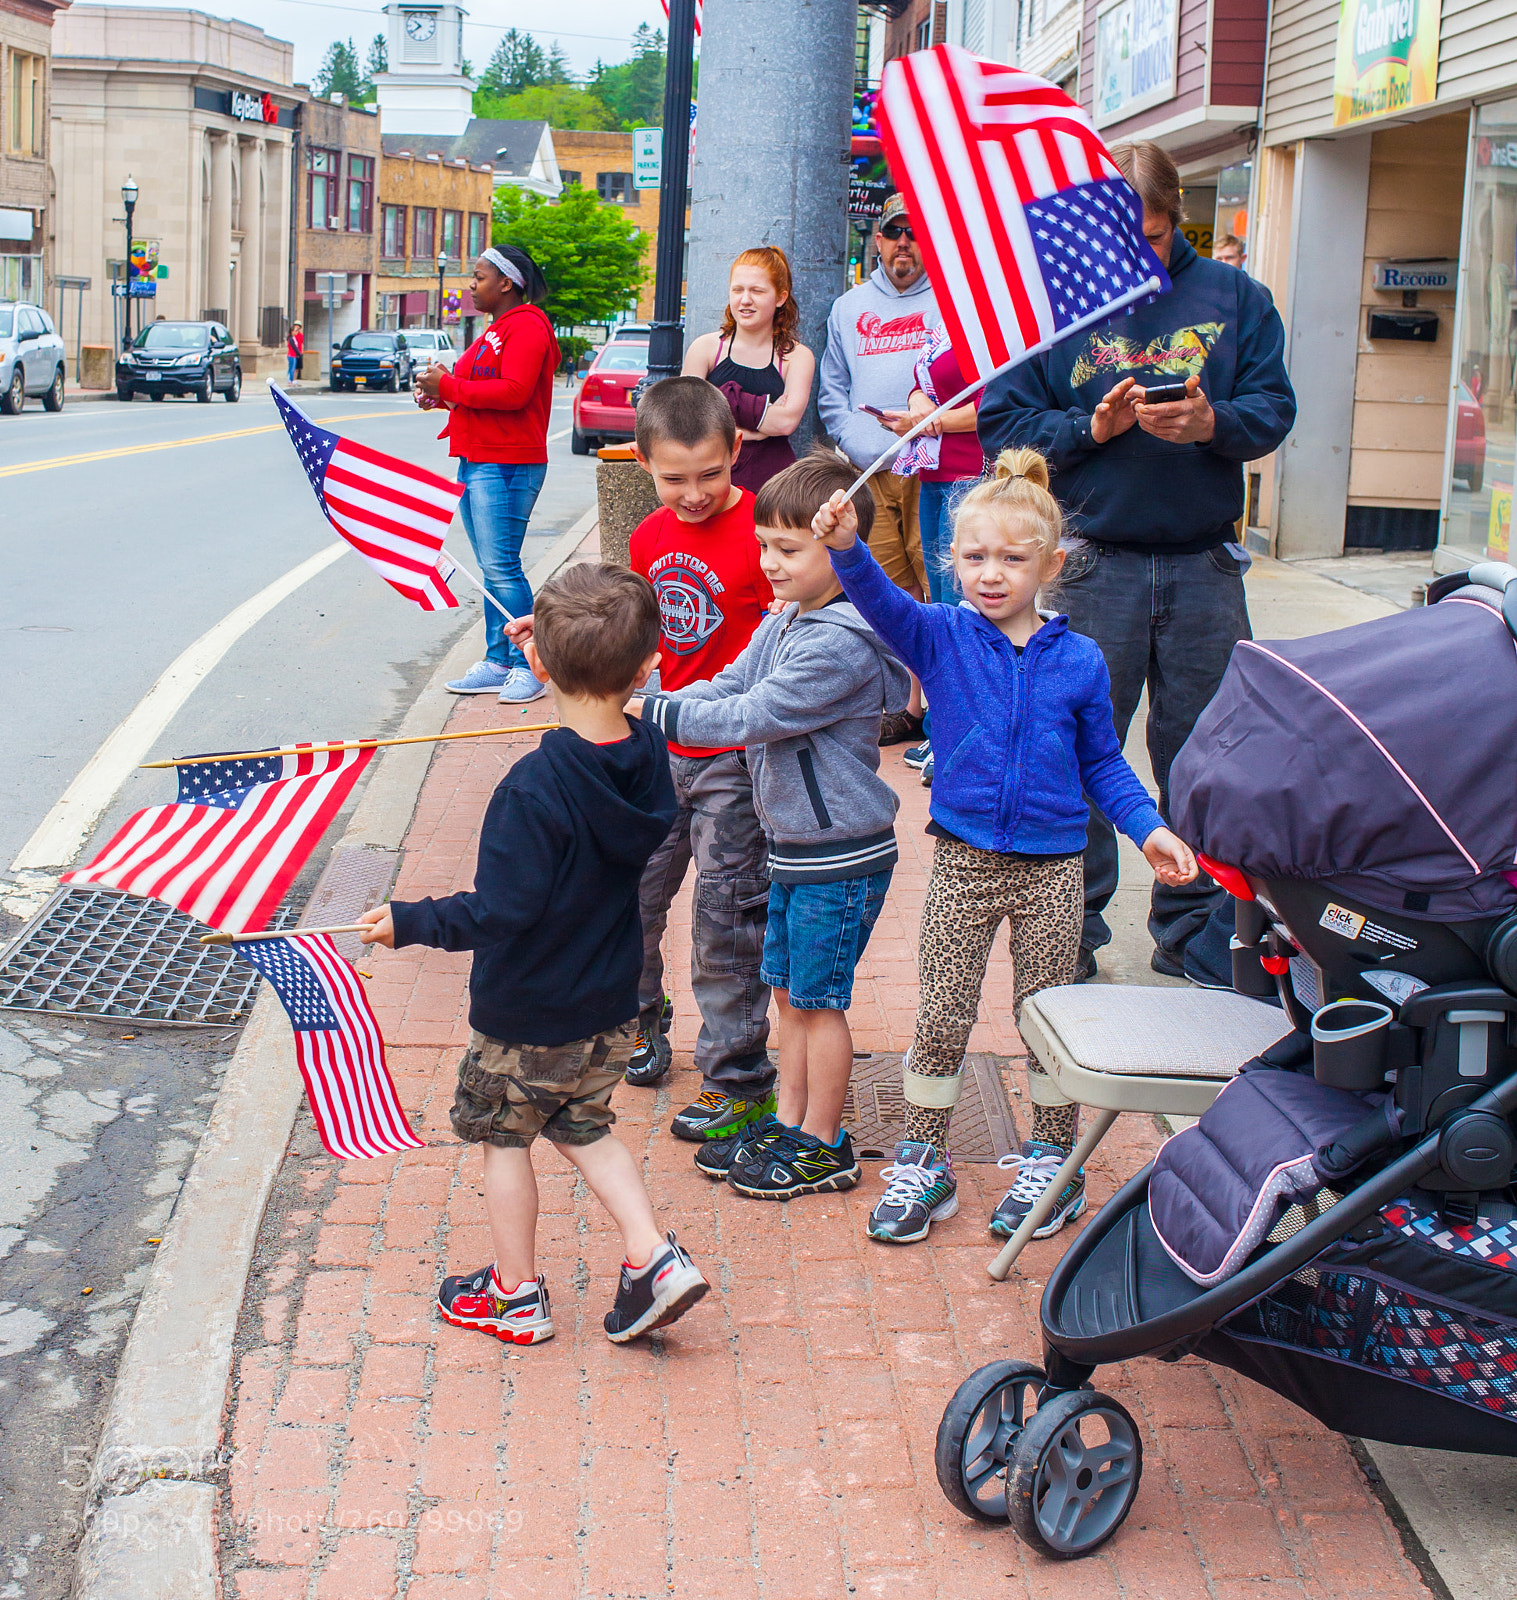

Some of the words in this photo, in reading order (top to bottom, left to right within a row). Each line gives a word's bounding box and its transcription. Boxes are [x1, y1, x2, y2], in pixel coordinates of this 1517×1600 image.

[1356, 0, 1414, 55] Gabriel
[231, 91, 264, 122] KeyBank
[1350, 83, 1387, 118] Mexican
[1388, 70, 1412, 108] Food
[1383, 269, 1448, 286] RECORD
[857, 329, 934, 356] INDIANS
[1091, 345, 1201, 365] Budweiser
[472, 365, 496, 377] YORK
[648, 552, 674, 580] CAN'T
[675, 552, 708, 574] STOP
[703, 570, 726, 596] ME
